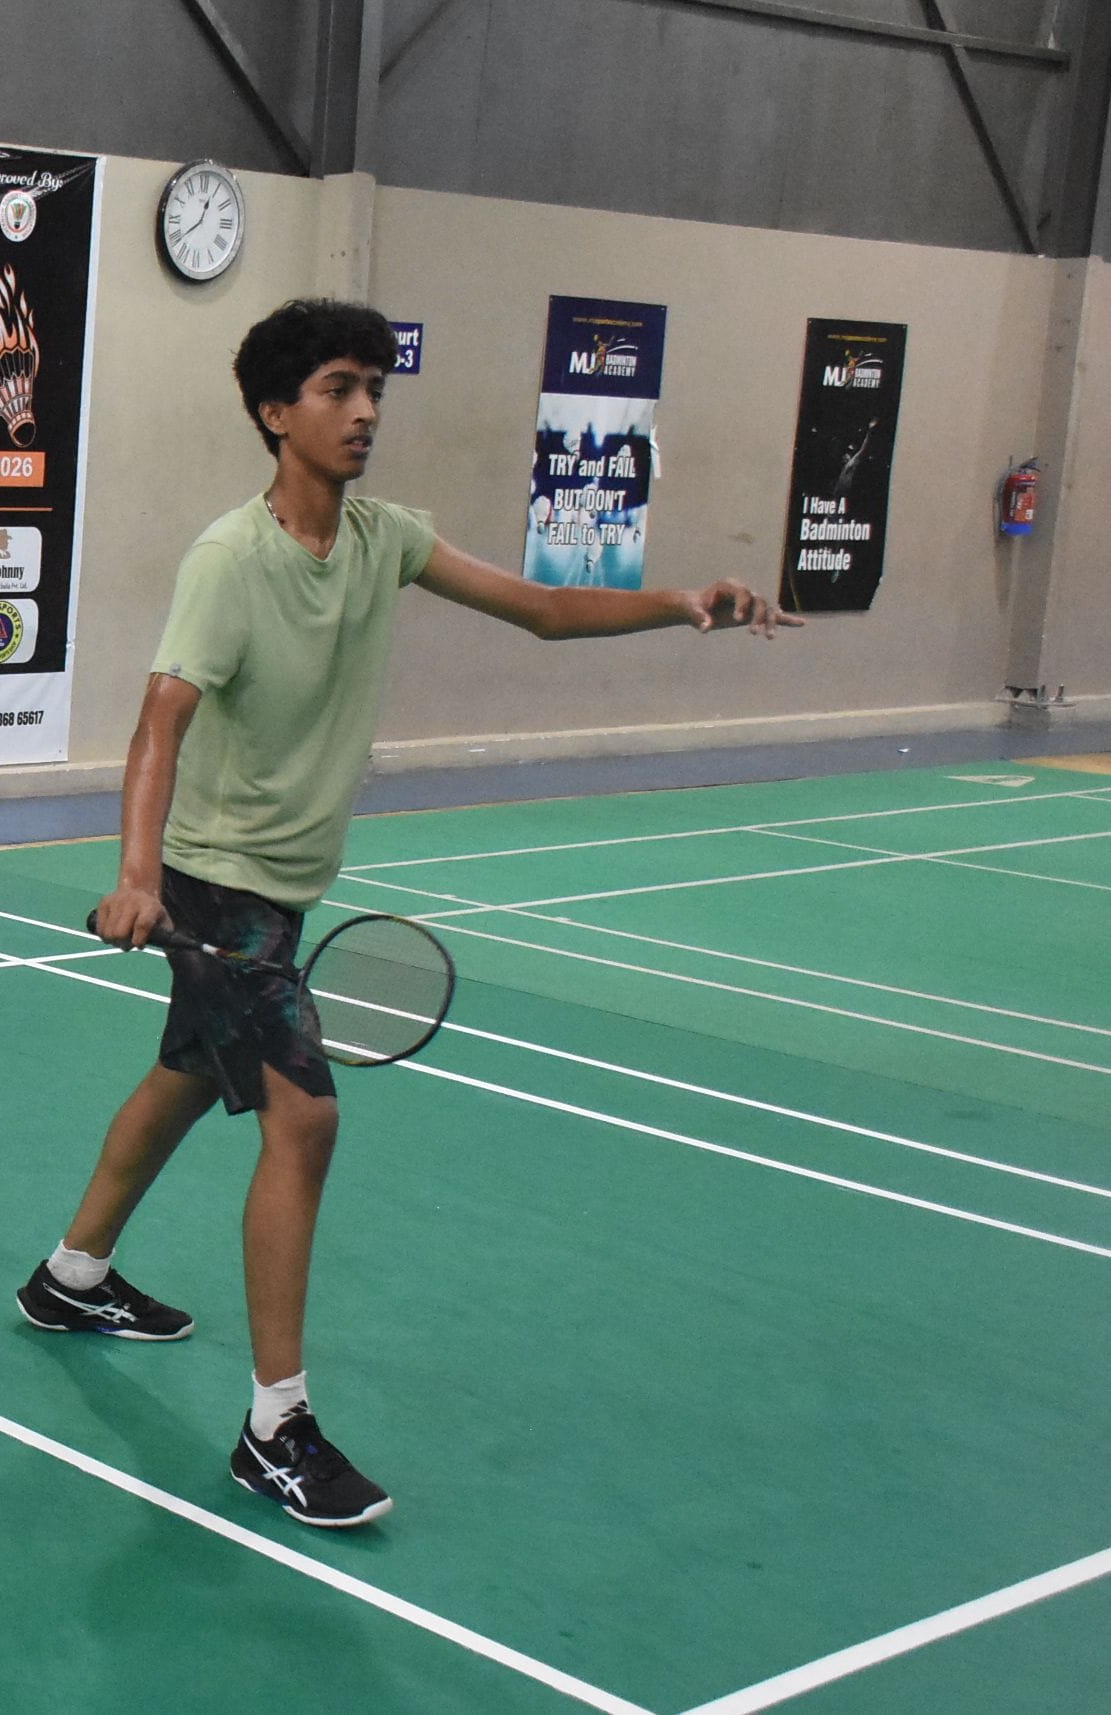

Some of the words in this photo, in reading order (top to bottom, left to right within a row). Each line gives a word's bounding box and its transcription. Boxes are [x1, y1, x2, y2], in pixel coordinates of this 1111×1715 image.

[393, 329, 419, 346] urt
[569, 351, 597, 375] MJ
[604, 365, 636, 377] ACADEMY
[548, 453, 577, 476] TRY
[578, 456, 605, 477] and
[607, 456, 636, 478] FAIL
[553, 488, 584, 510] BUT
[585, 489, 626, 511] DON'T
[803, 496, 808, 514] I
[810, 496, 836, 514] Have
[837, 496, 846, 514] A
[548, 522, 578, 545] FAIL
[581, 523, 595, 545] to
[599, 523, 626, 545] TRY
[799, 518, 871, 540] Badminton
[797, 547, 851, 571] Attitude
[17, 710, 44, 725] 65617
